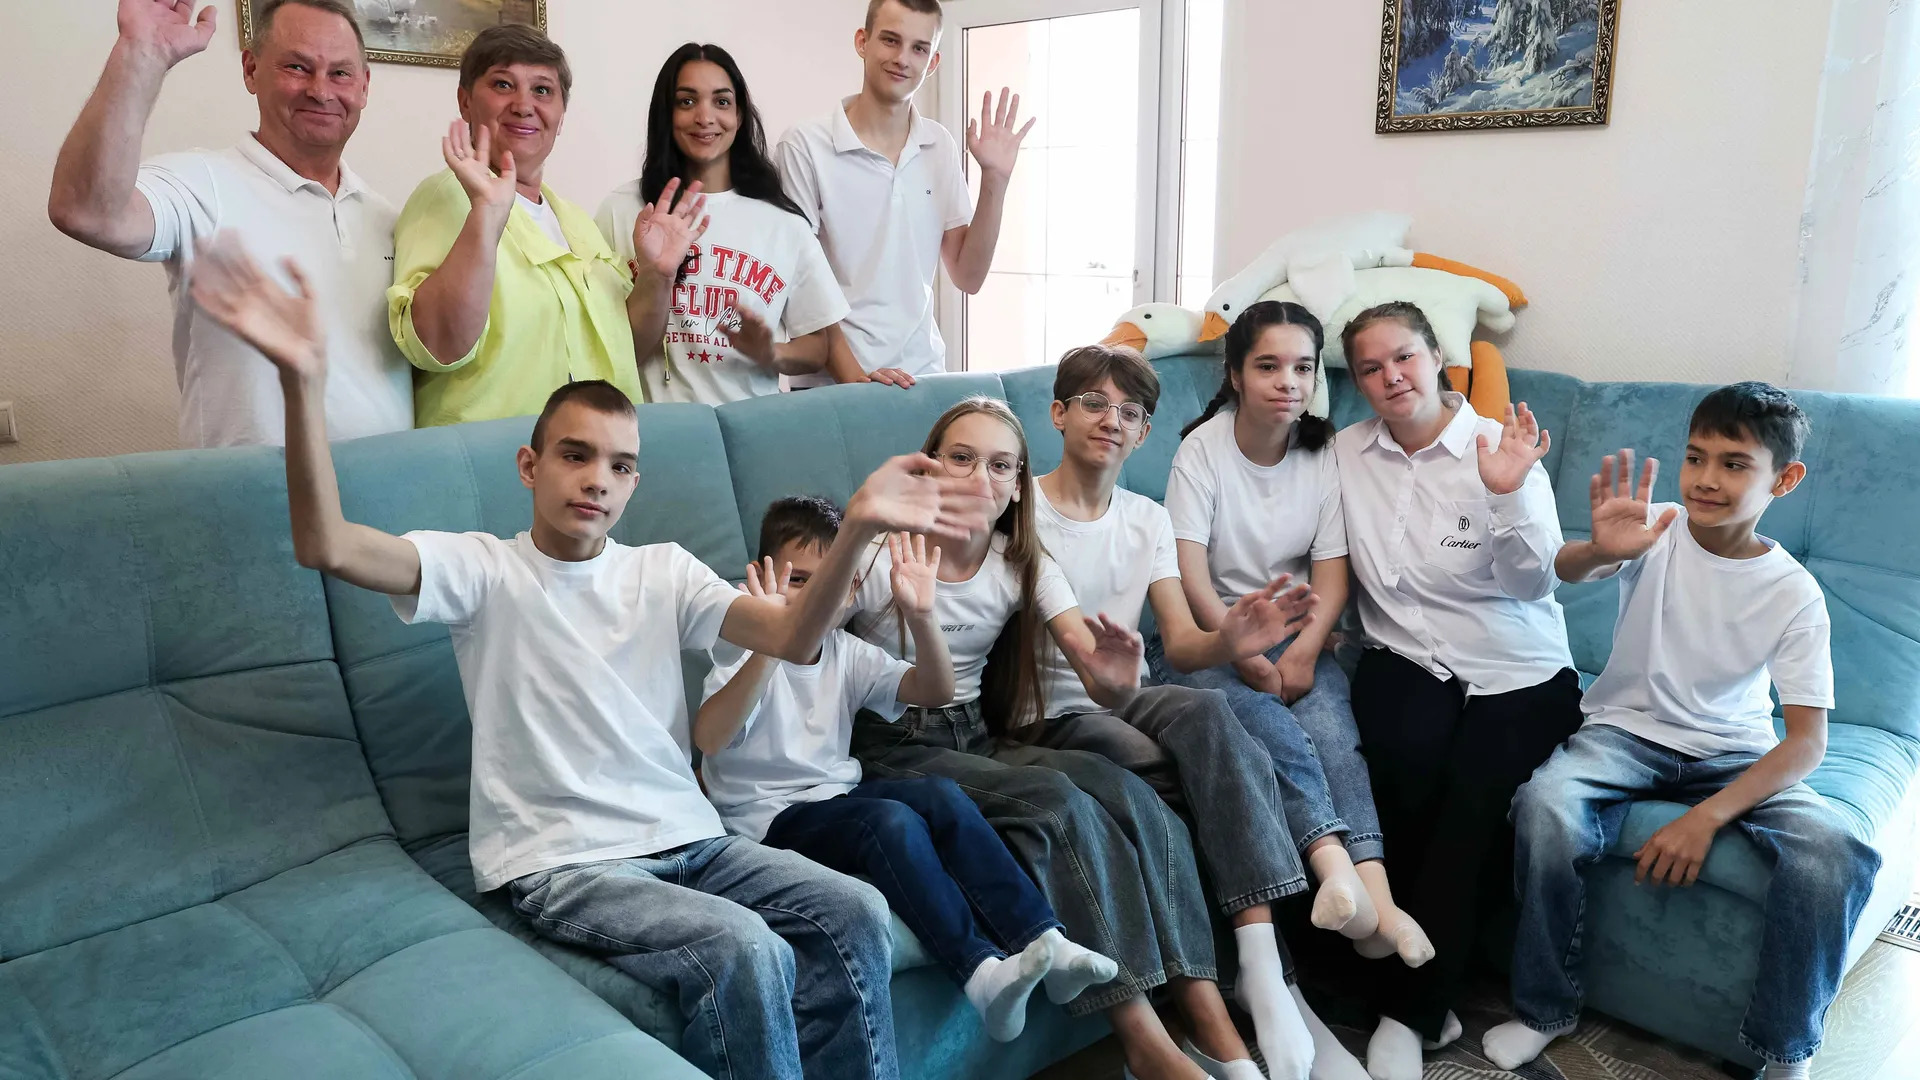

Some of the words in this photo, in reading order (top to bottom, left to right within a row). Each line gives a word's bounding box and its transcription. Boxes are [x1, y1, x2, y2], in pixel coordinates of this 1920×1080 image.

[711, 244, 787, 308] TIME
[666, 331, 710, 345] GETHER
[1440, 535, 1482, 550] Cartier
